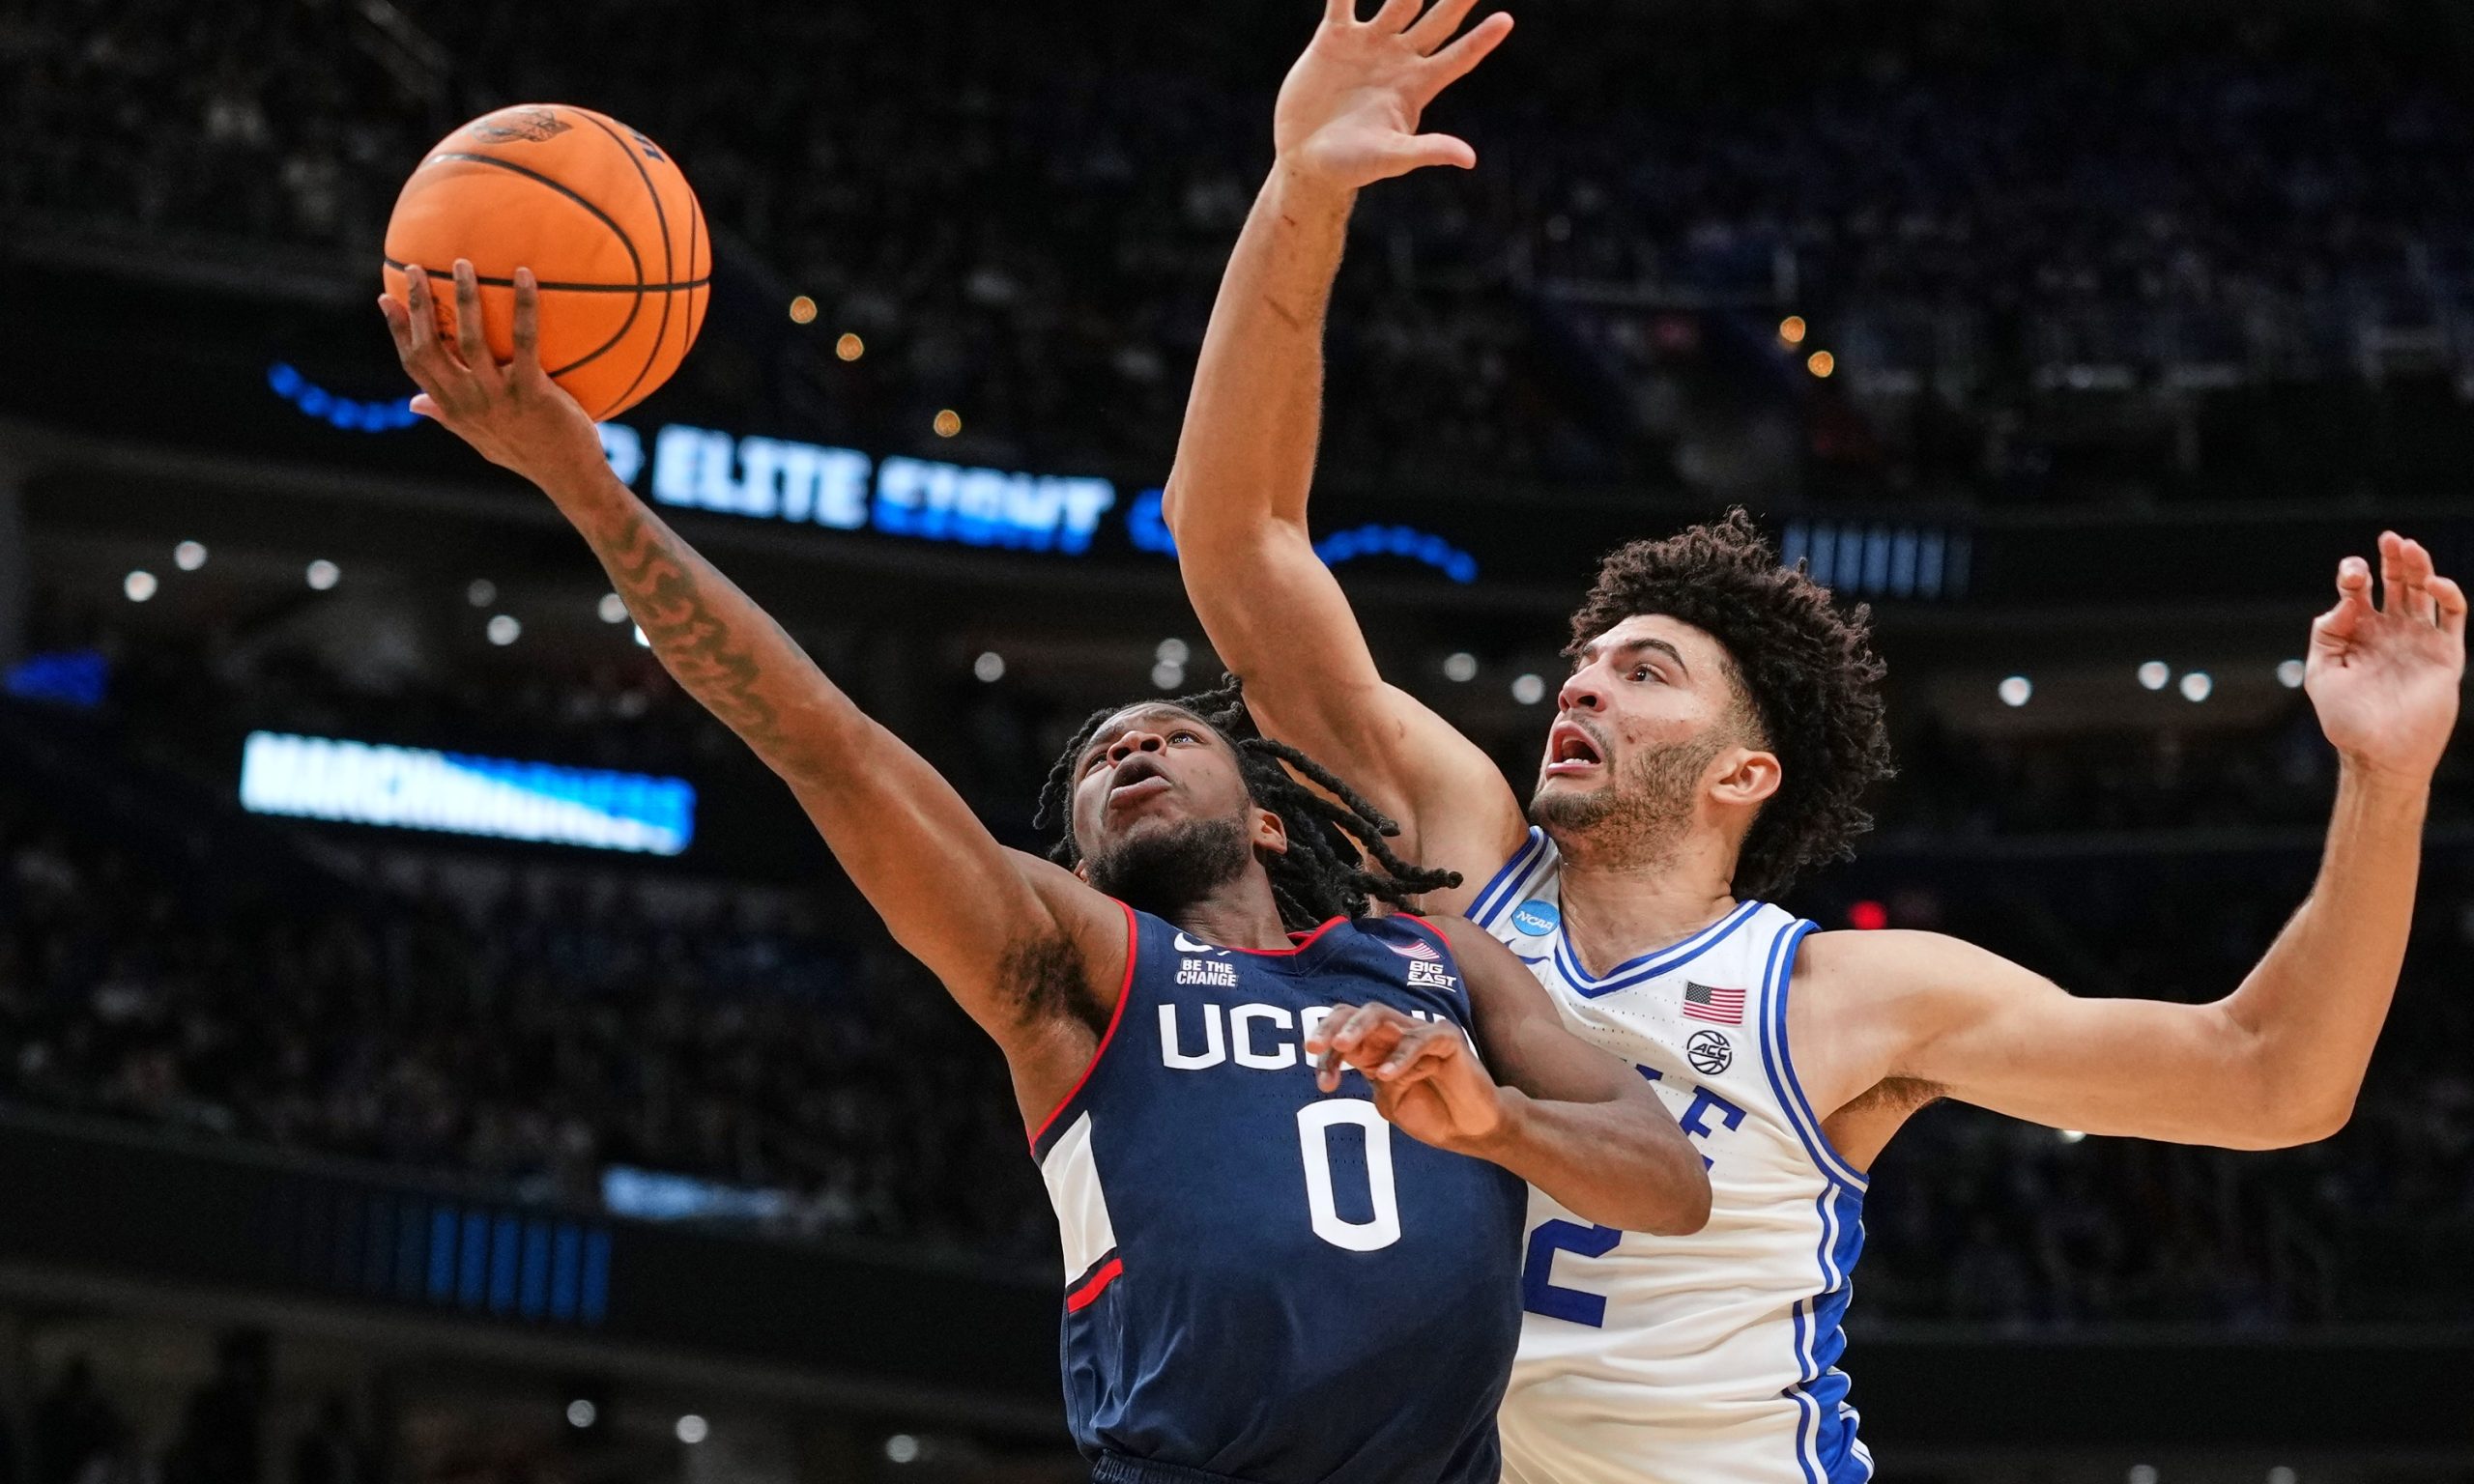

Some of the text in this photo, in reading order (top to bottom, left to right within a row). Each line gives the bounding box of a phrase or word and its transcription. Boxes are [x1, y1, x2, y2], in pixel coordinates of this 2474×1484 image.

[651, 423, 870, 529] ELITE
[1516, 910, 1554, 930] NCAA
[1182, 959, 1234, 974] BE THE
[1409, 960, 1444, 974] BIG
[1176, 971, 1236, 986] CHANGE
[1408, 971, 1456, 986] EAST
[1692, 1042, 1731, 1059] ACC
[1297, 1099, 1401, 1252] 0
